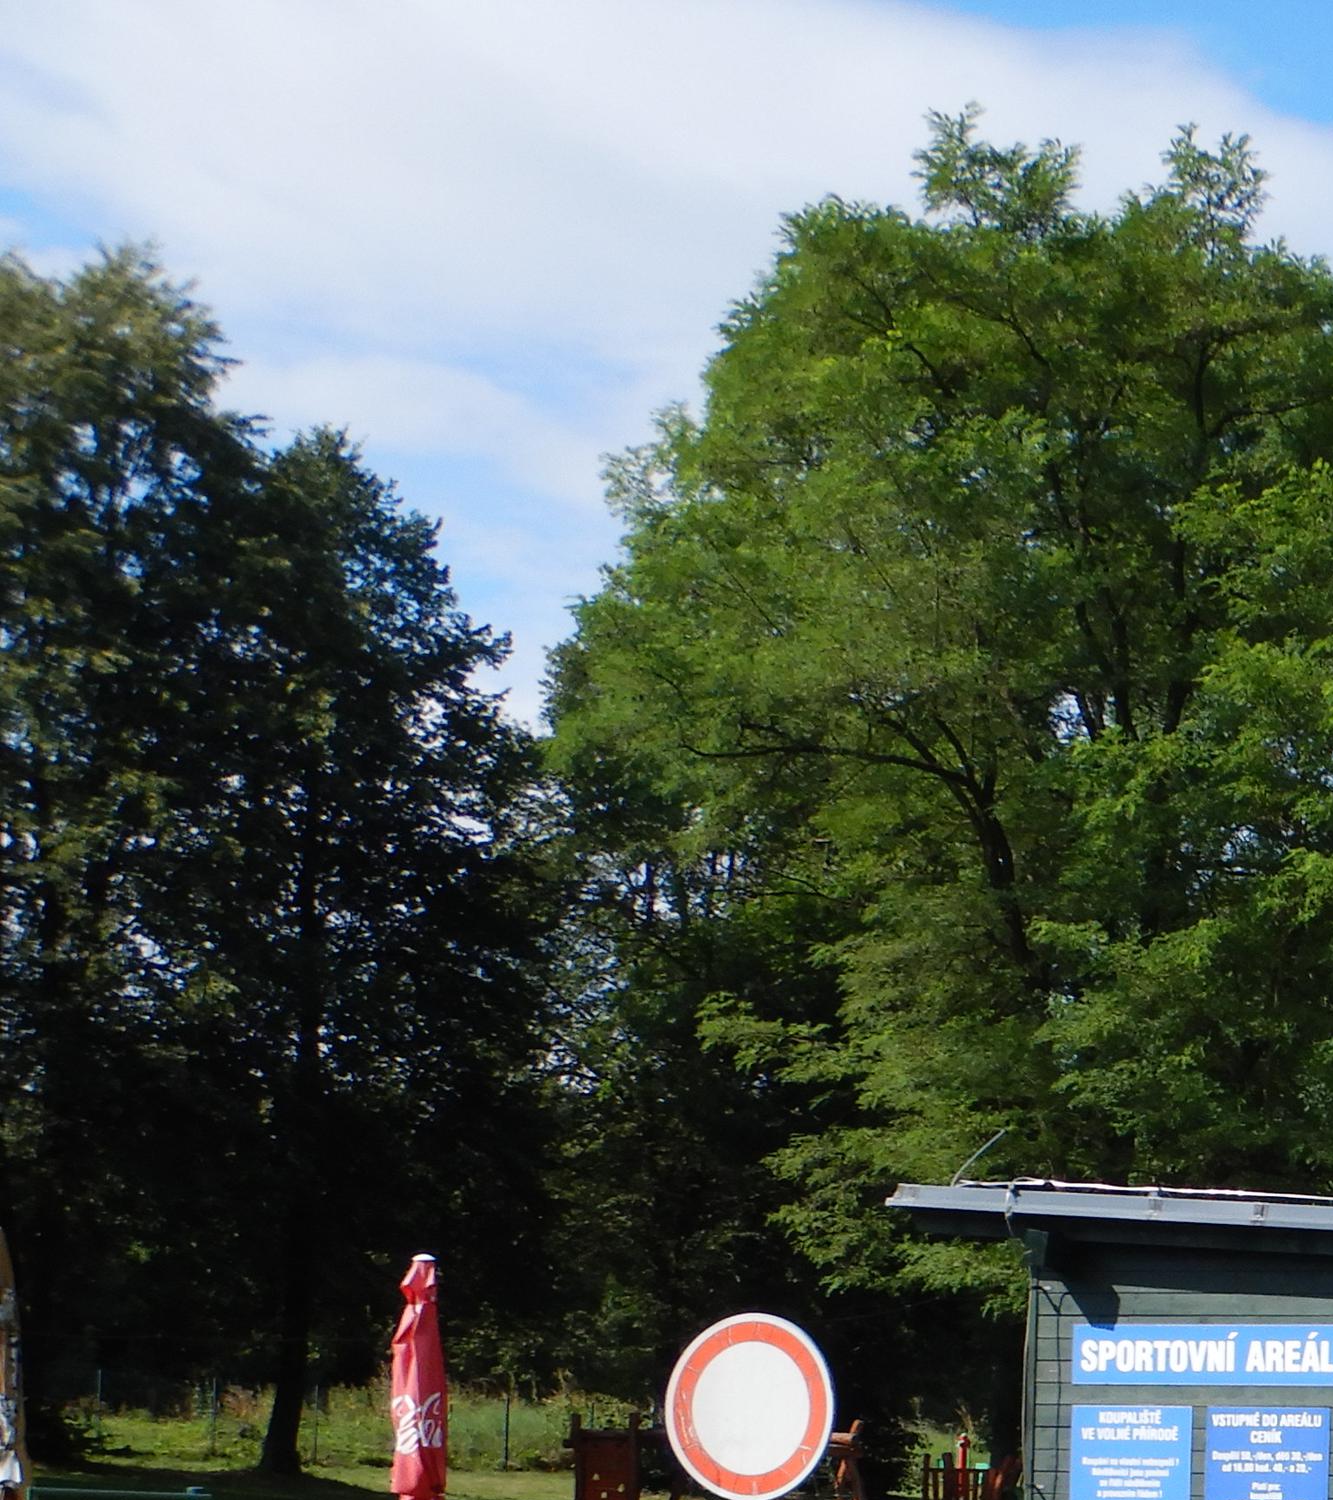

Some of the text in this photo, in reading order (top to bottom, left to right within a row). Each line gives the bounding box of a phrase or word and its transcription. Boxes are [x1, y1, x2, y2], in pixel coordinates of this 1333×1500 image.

[1080, 1332, 1239, 1373] SPORTOVNÍ
[1099, 1410, 1161, 1424] KOUPALIŠTĚ
[1212, 1412, 1322, 1427] VSTUPNÉ DO AREÁLU
[1081, 1428, 1095, 1439] VE
[1250, 1428, 1282, 1443] CENÍK
